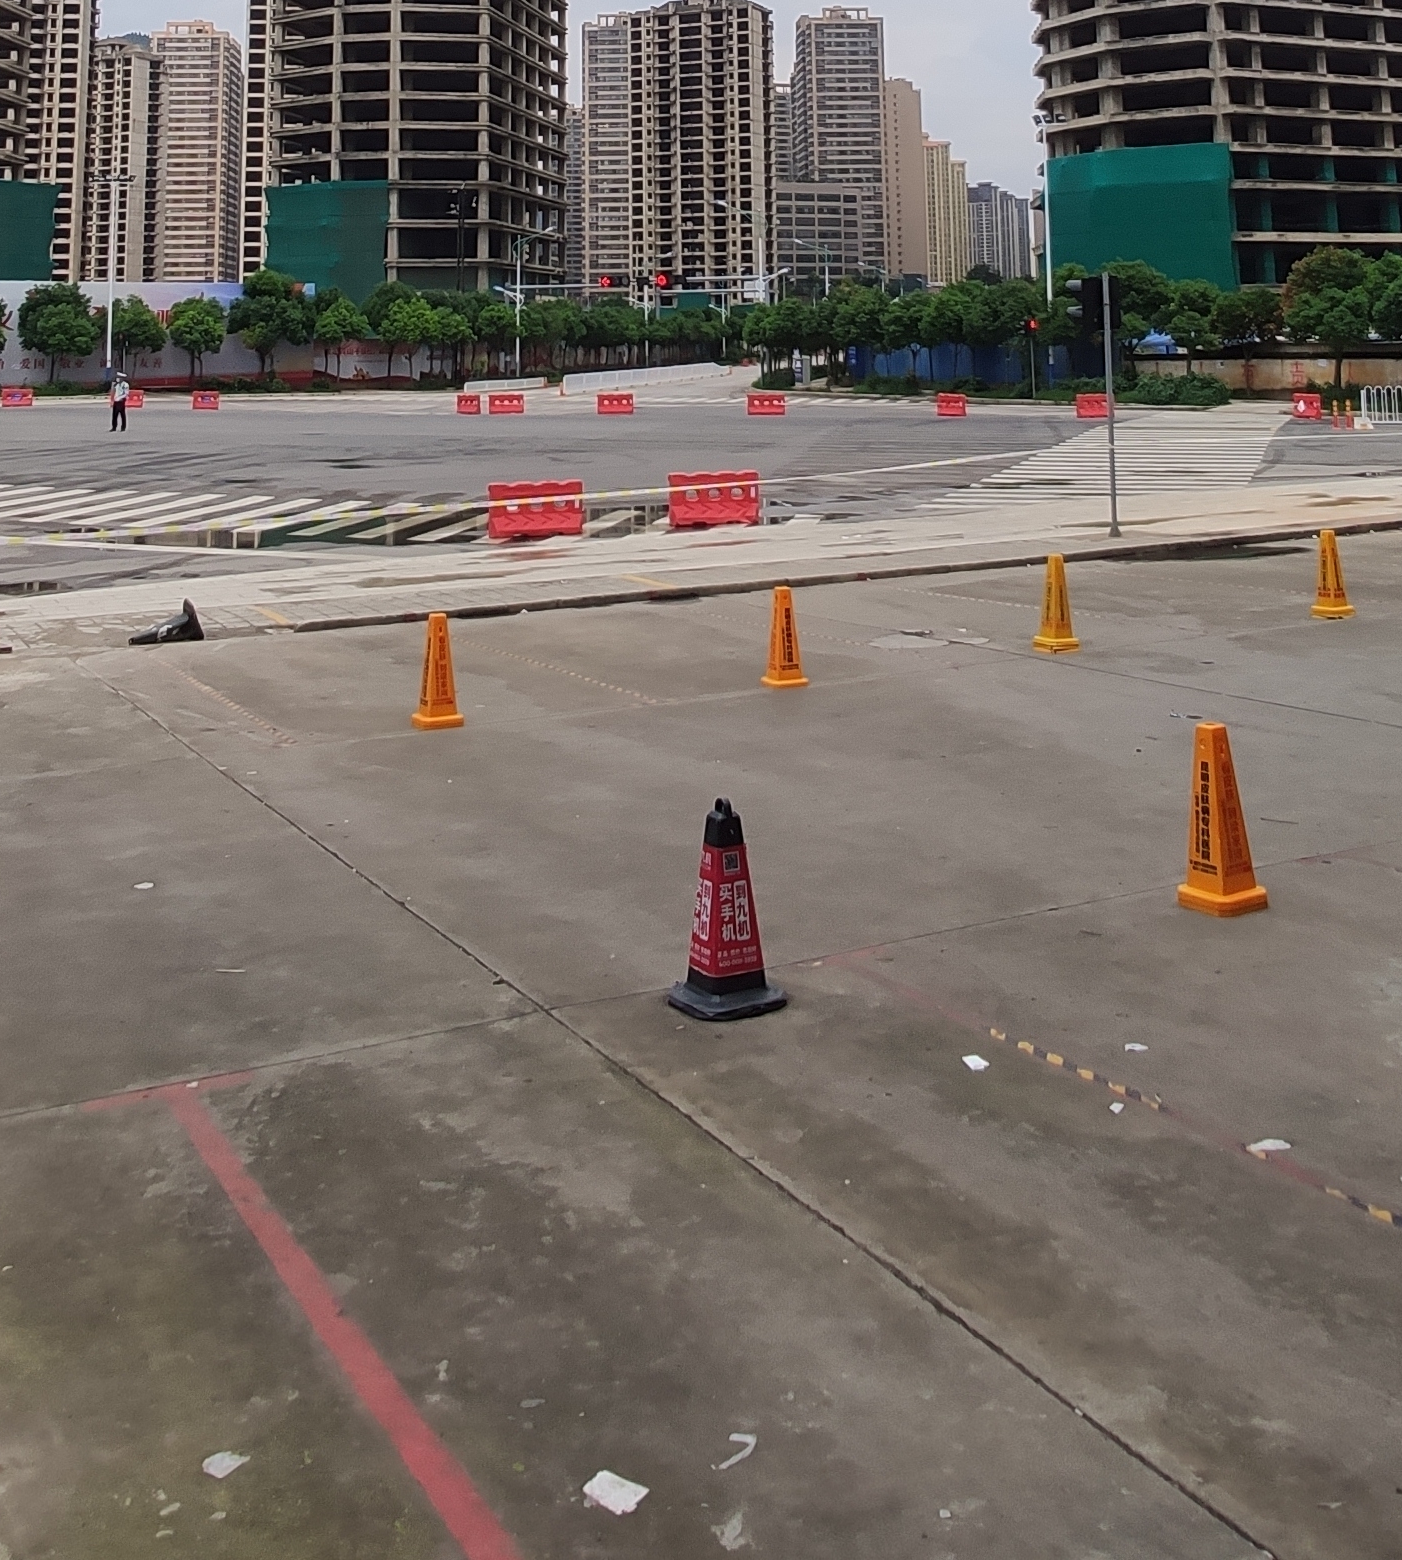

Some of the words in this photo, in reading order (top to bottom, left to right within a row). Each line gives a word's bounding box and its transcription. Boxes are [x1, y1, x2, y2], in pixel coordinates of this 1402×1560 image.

[719, 883, 736, 942] 买手机
[735, 884, 750, 938] 到九机
